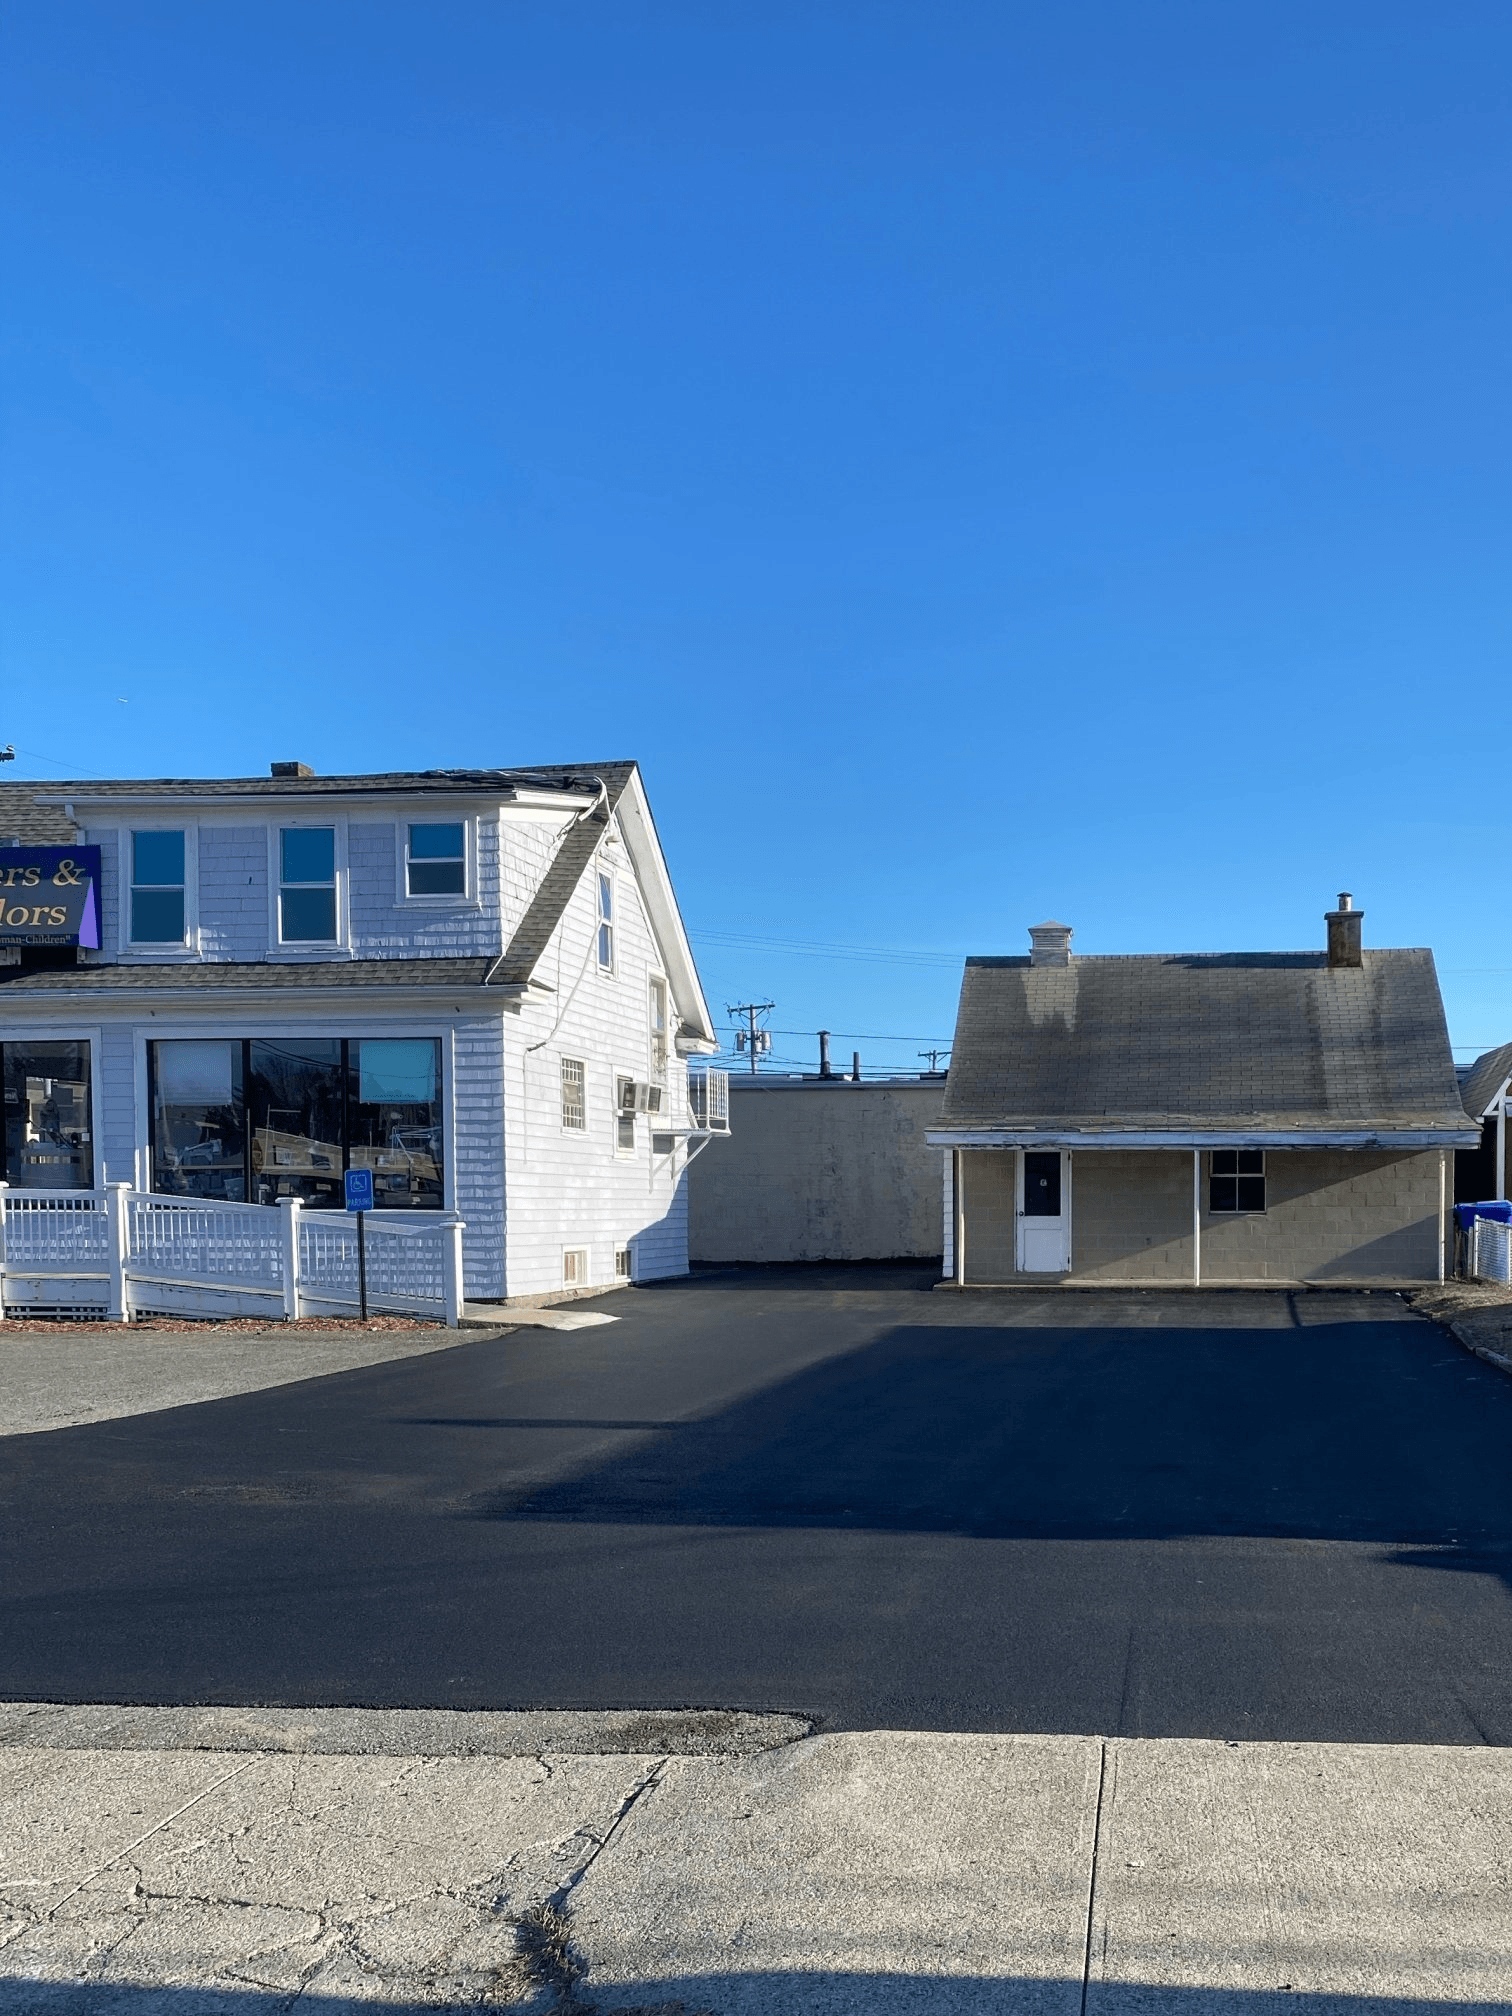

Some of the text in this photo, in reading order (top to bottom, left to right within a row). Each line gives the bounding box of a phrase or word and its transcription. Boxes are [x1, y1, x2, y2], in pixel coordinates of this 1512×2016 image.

[0, 859, 86, 886] rs &
[0, 935, 71, 944] man-Children"
